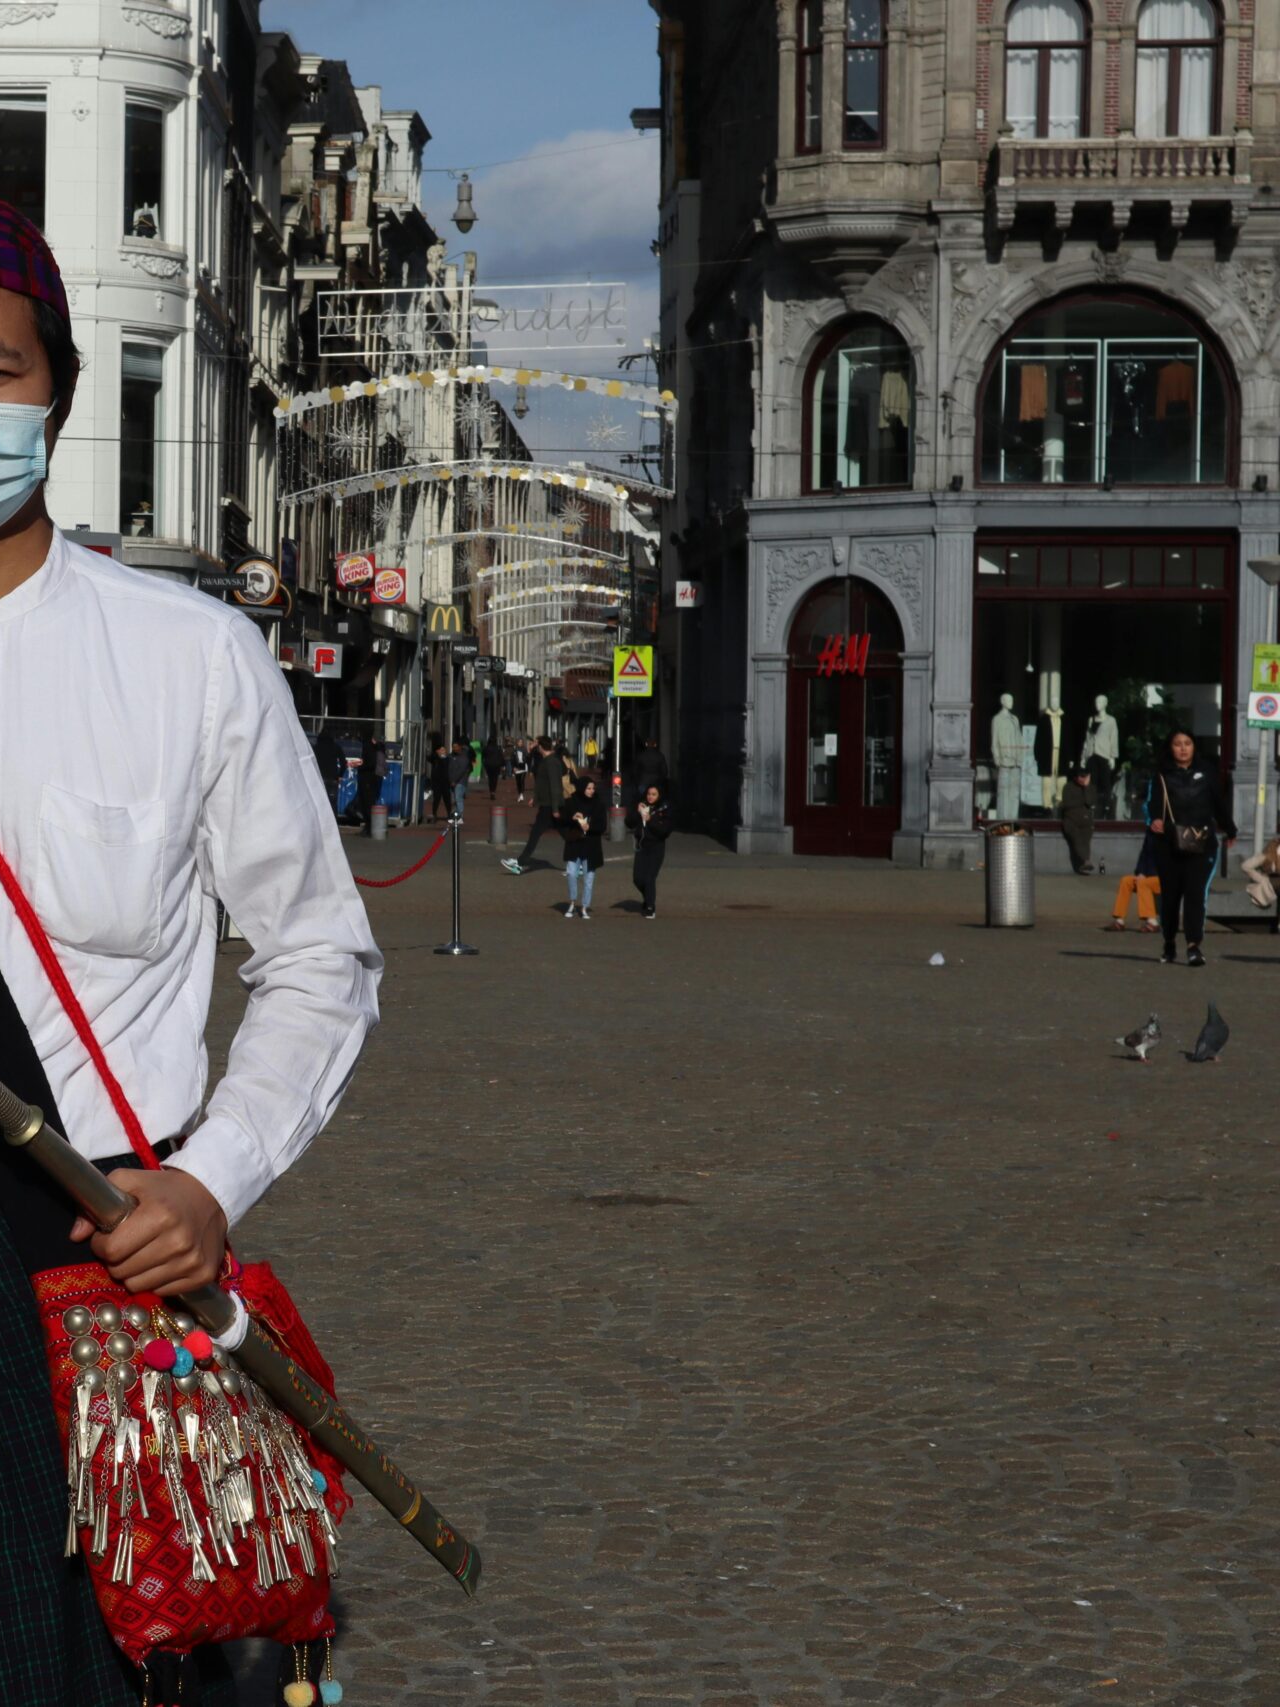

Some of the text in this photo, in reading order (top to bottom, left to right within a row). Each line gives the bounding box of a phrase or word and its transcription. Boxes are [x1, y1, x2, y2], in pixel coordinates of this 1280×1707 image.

[344, 568, 369, 581] KING
[201, 577, 245, 586] SWAROVSKI
[377, 581, 401, 593] KING
[816, 632, 871, 678] H&M
